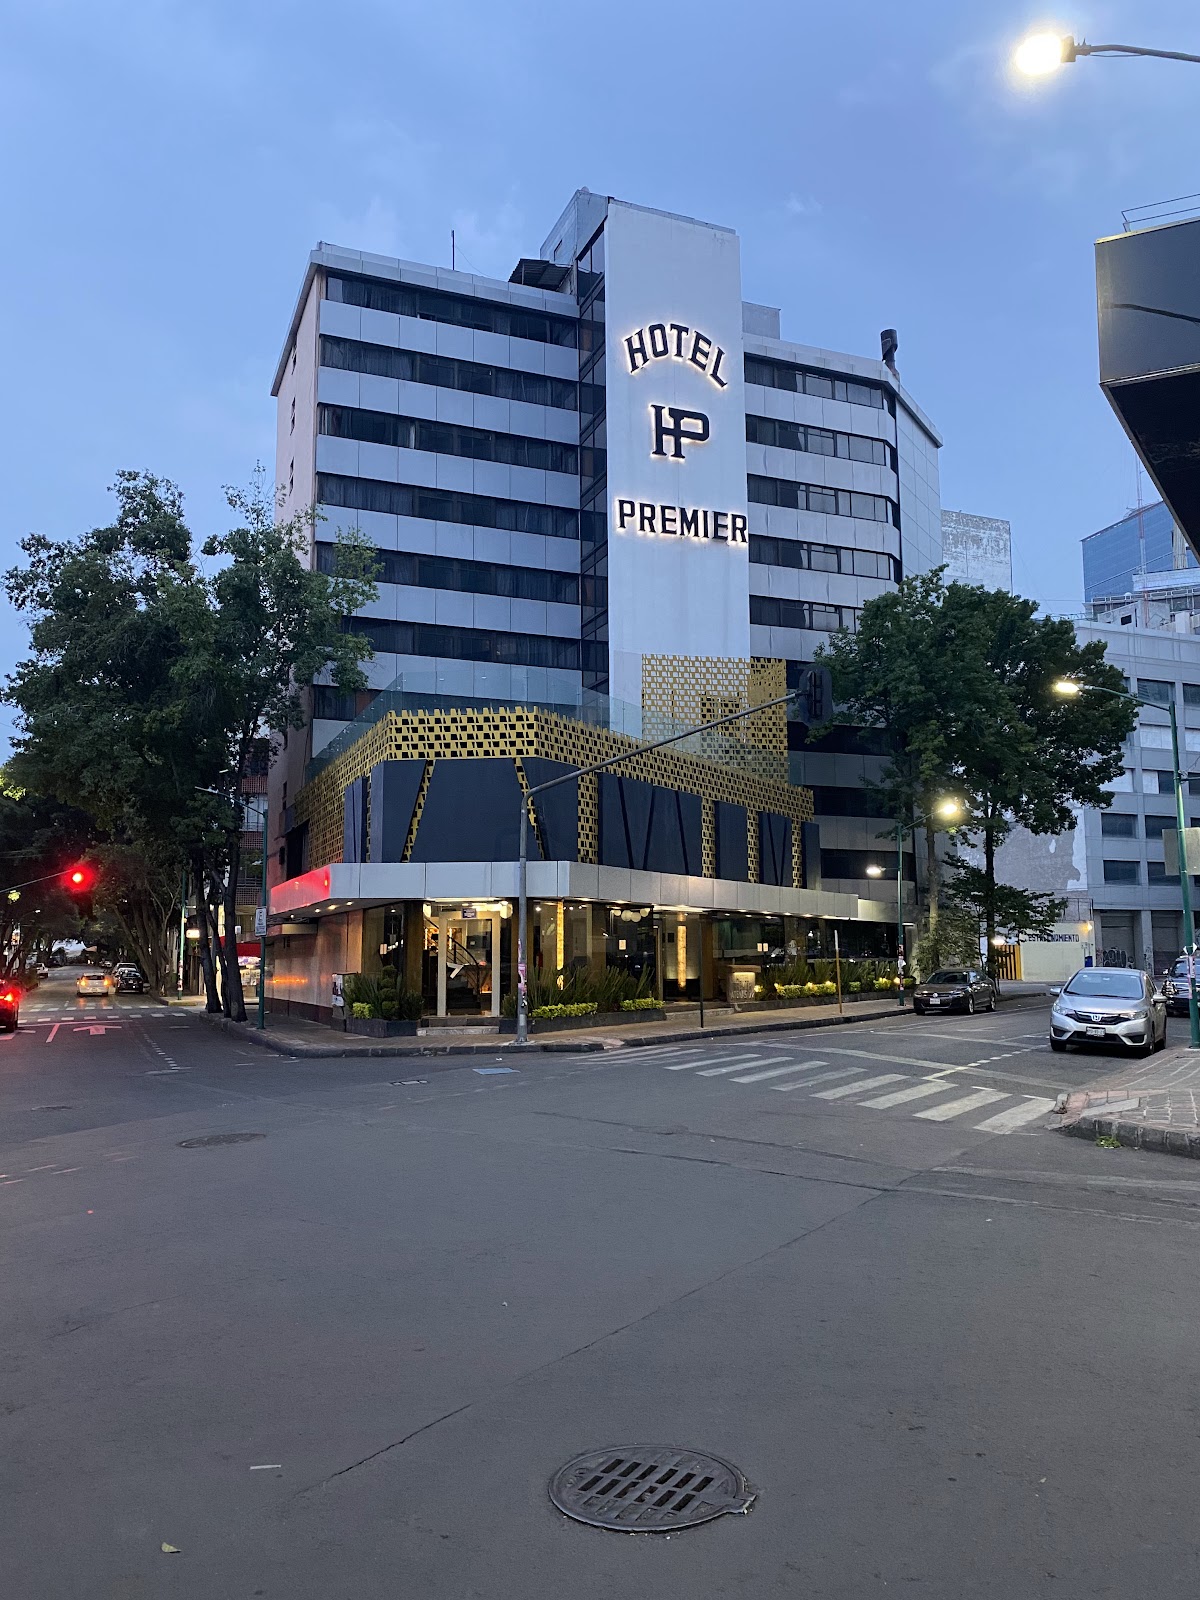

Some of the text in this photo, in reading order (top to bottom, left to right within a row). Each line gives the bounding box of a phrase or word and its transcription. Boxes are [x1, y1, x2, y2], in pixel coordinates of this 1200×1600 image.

[624, 323, 728, 388] HOTEL
[650, 404, 710, 459] HP
[617, 499, 749, 543] PREMIER
